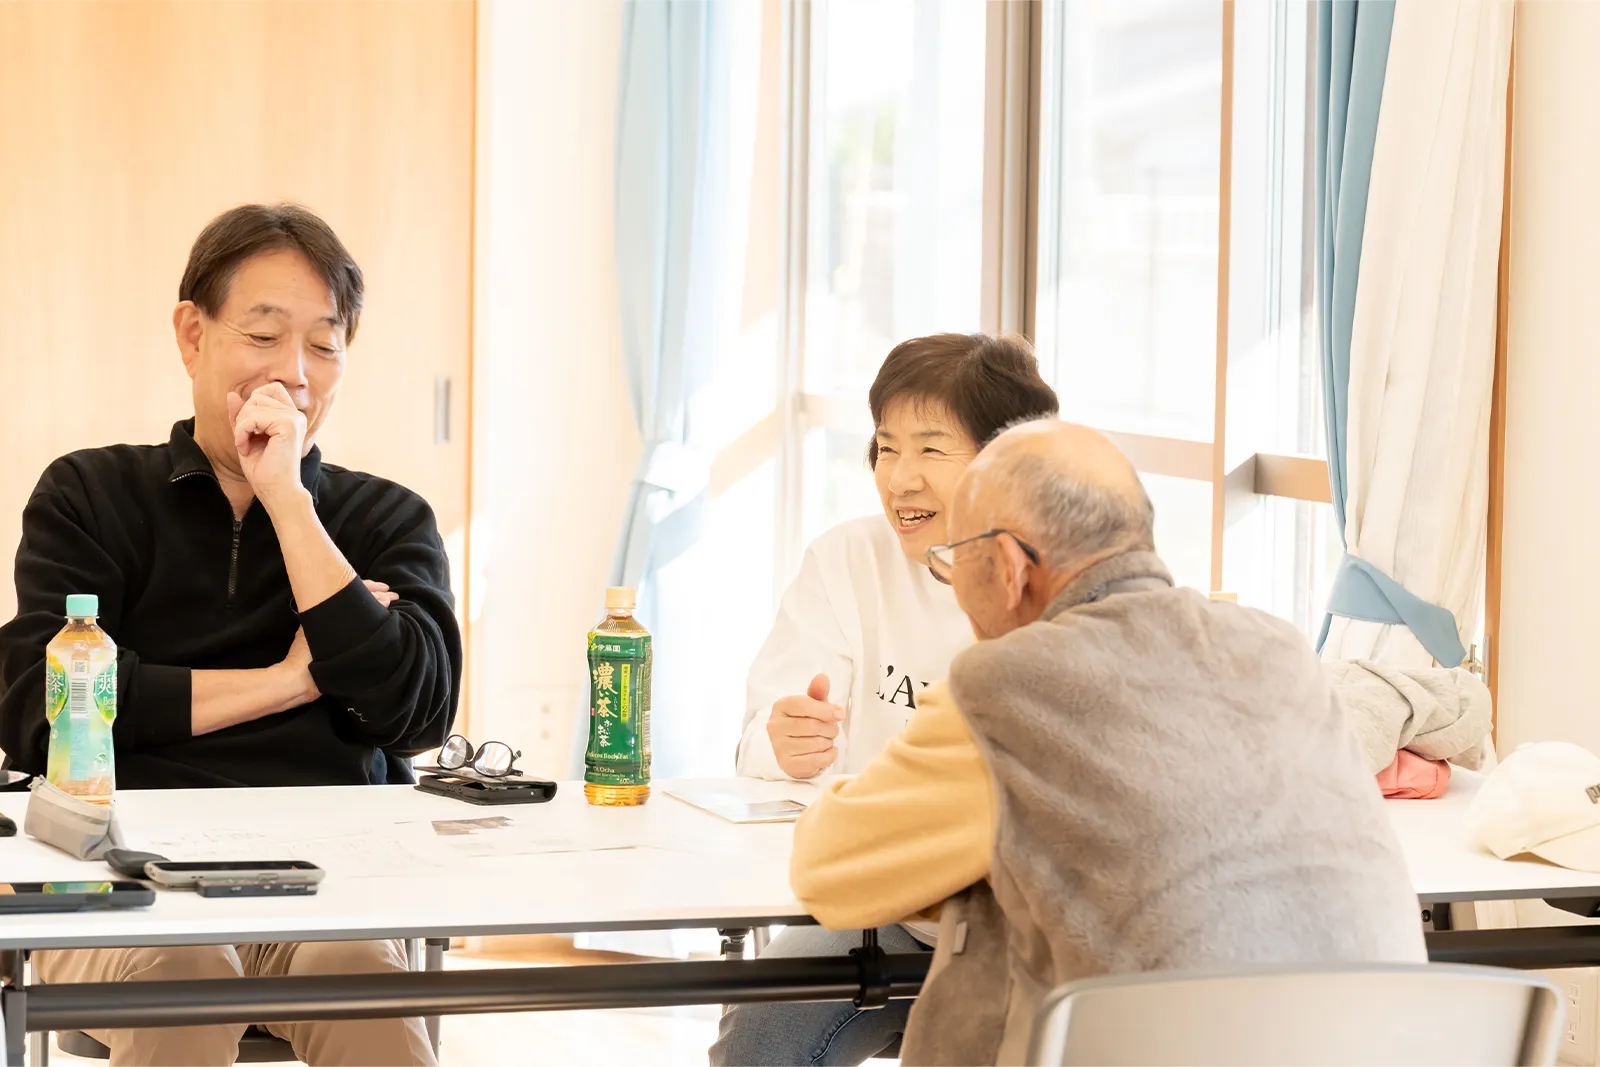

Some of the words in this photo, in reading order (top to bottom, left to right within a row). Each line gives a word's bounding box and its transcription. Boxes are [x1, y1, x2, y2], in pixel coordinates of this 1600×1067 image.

[598, 644, 621, 652] 伊藤園
[592, 662, 618, 719] 濃い茶
